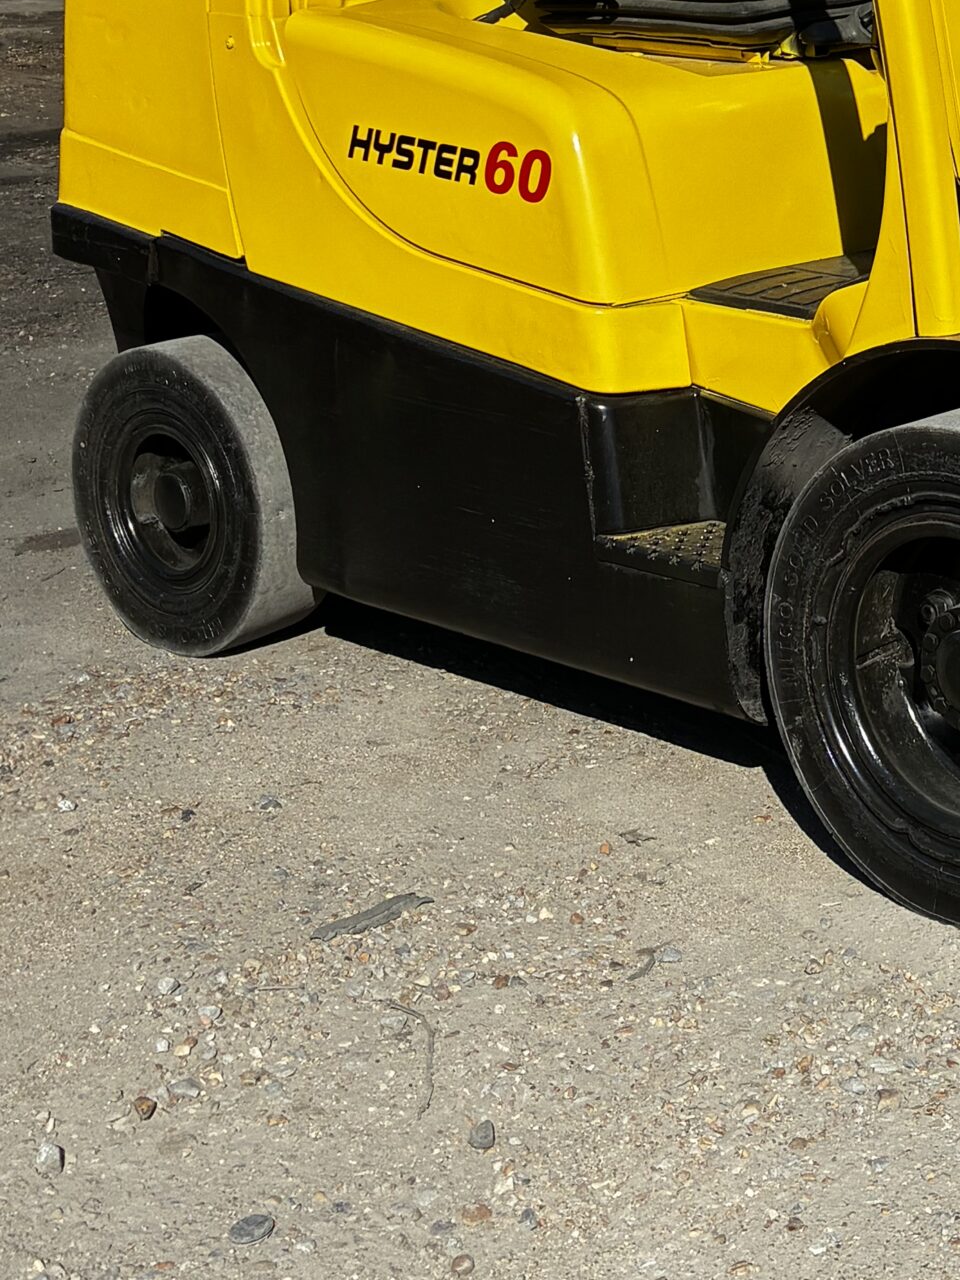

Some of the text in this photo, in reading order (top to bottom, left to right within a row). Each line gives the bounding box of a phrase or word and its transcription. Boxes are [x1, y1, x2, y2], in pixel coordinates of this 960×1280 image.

[348, 125, 552, 203] HYSTER 60
[818, 446, 894, 512] SOLVER
